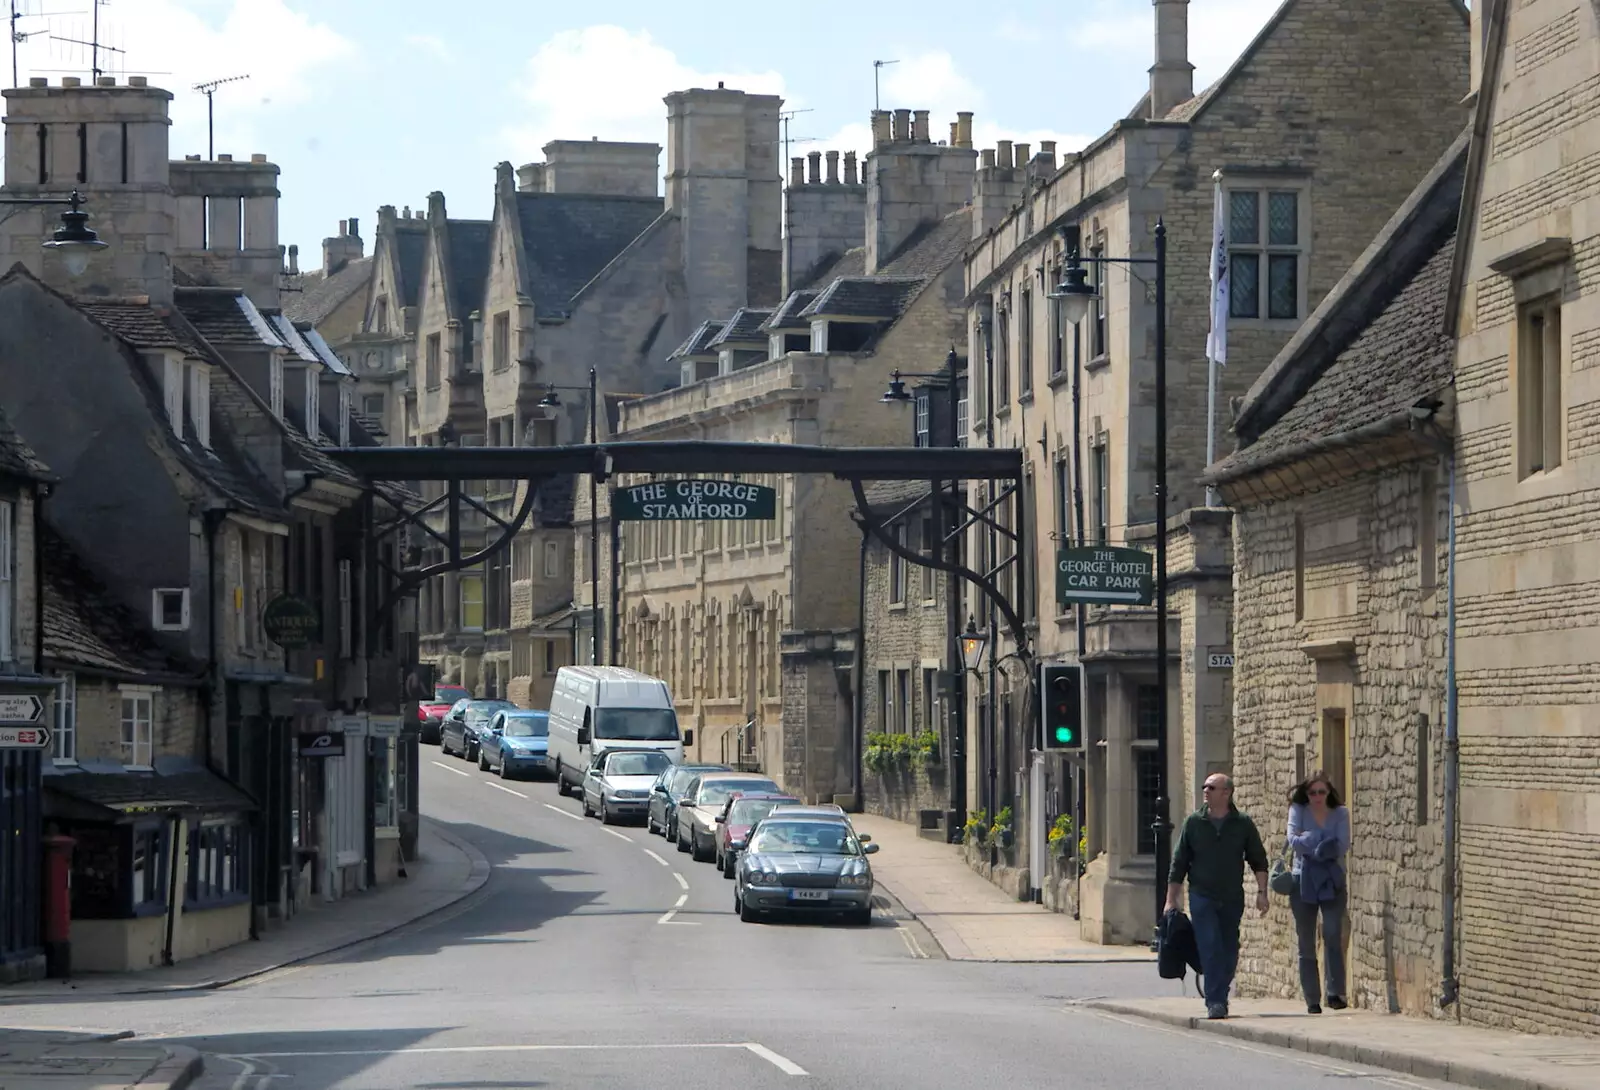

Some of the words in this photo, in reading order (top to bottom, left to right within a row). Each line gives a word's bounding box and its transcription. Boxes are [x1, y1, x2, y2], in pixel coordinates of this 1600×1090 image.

[628, 483, 667, 503] THE
[676, 481, 760, 502] GEORGE
[687, 495, 703, 505] OF
[643, 504, 747, 518] STAMFORD
[1094, 551, 1115, 561] THE
[1059, 560, 1106, 573] GEORGE
[1110, 562, 1150, 575] HOTEL
[1068, 574, 1098, 587] CAR
[1105, 576, 1141, 588] PARK
[267, 616, 318, 629] ANTIQUES
[1211, 655, 1234, 665] STA
